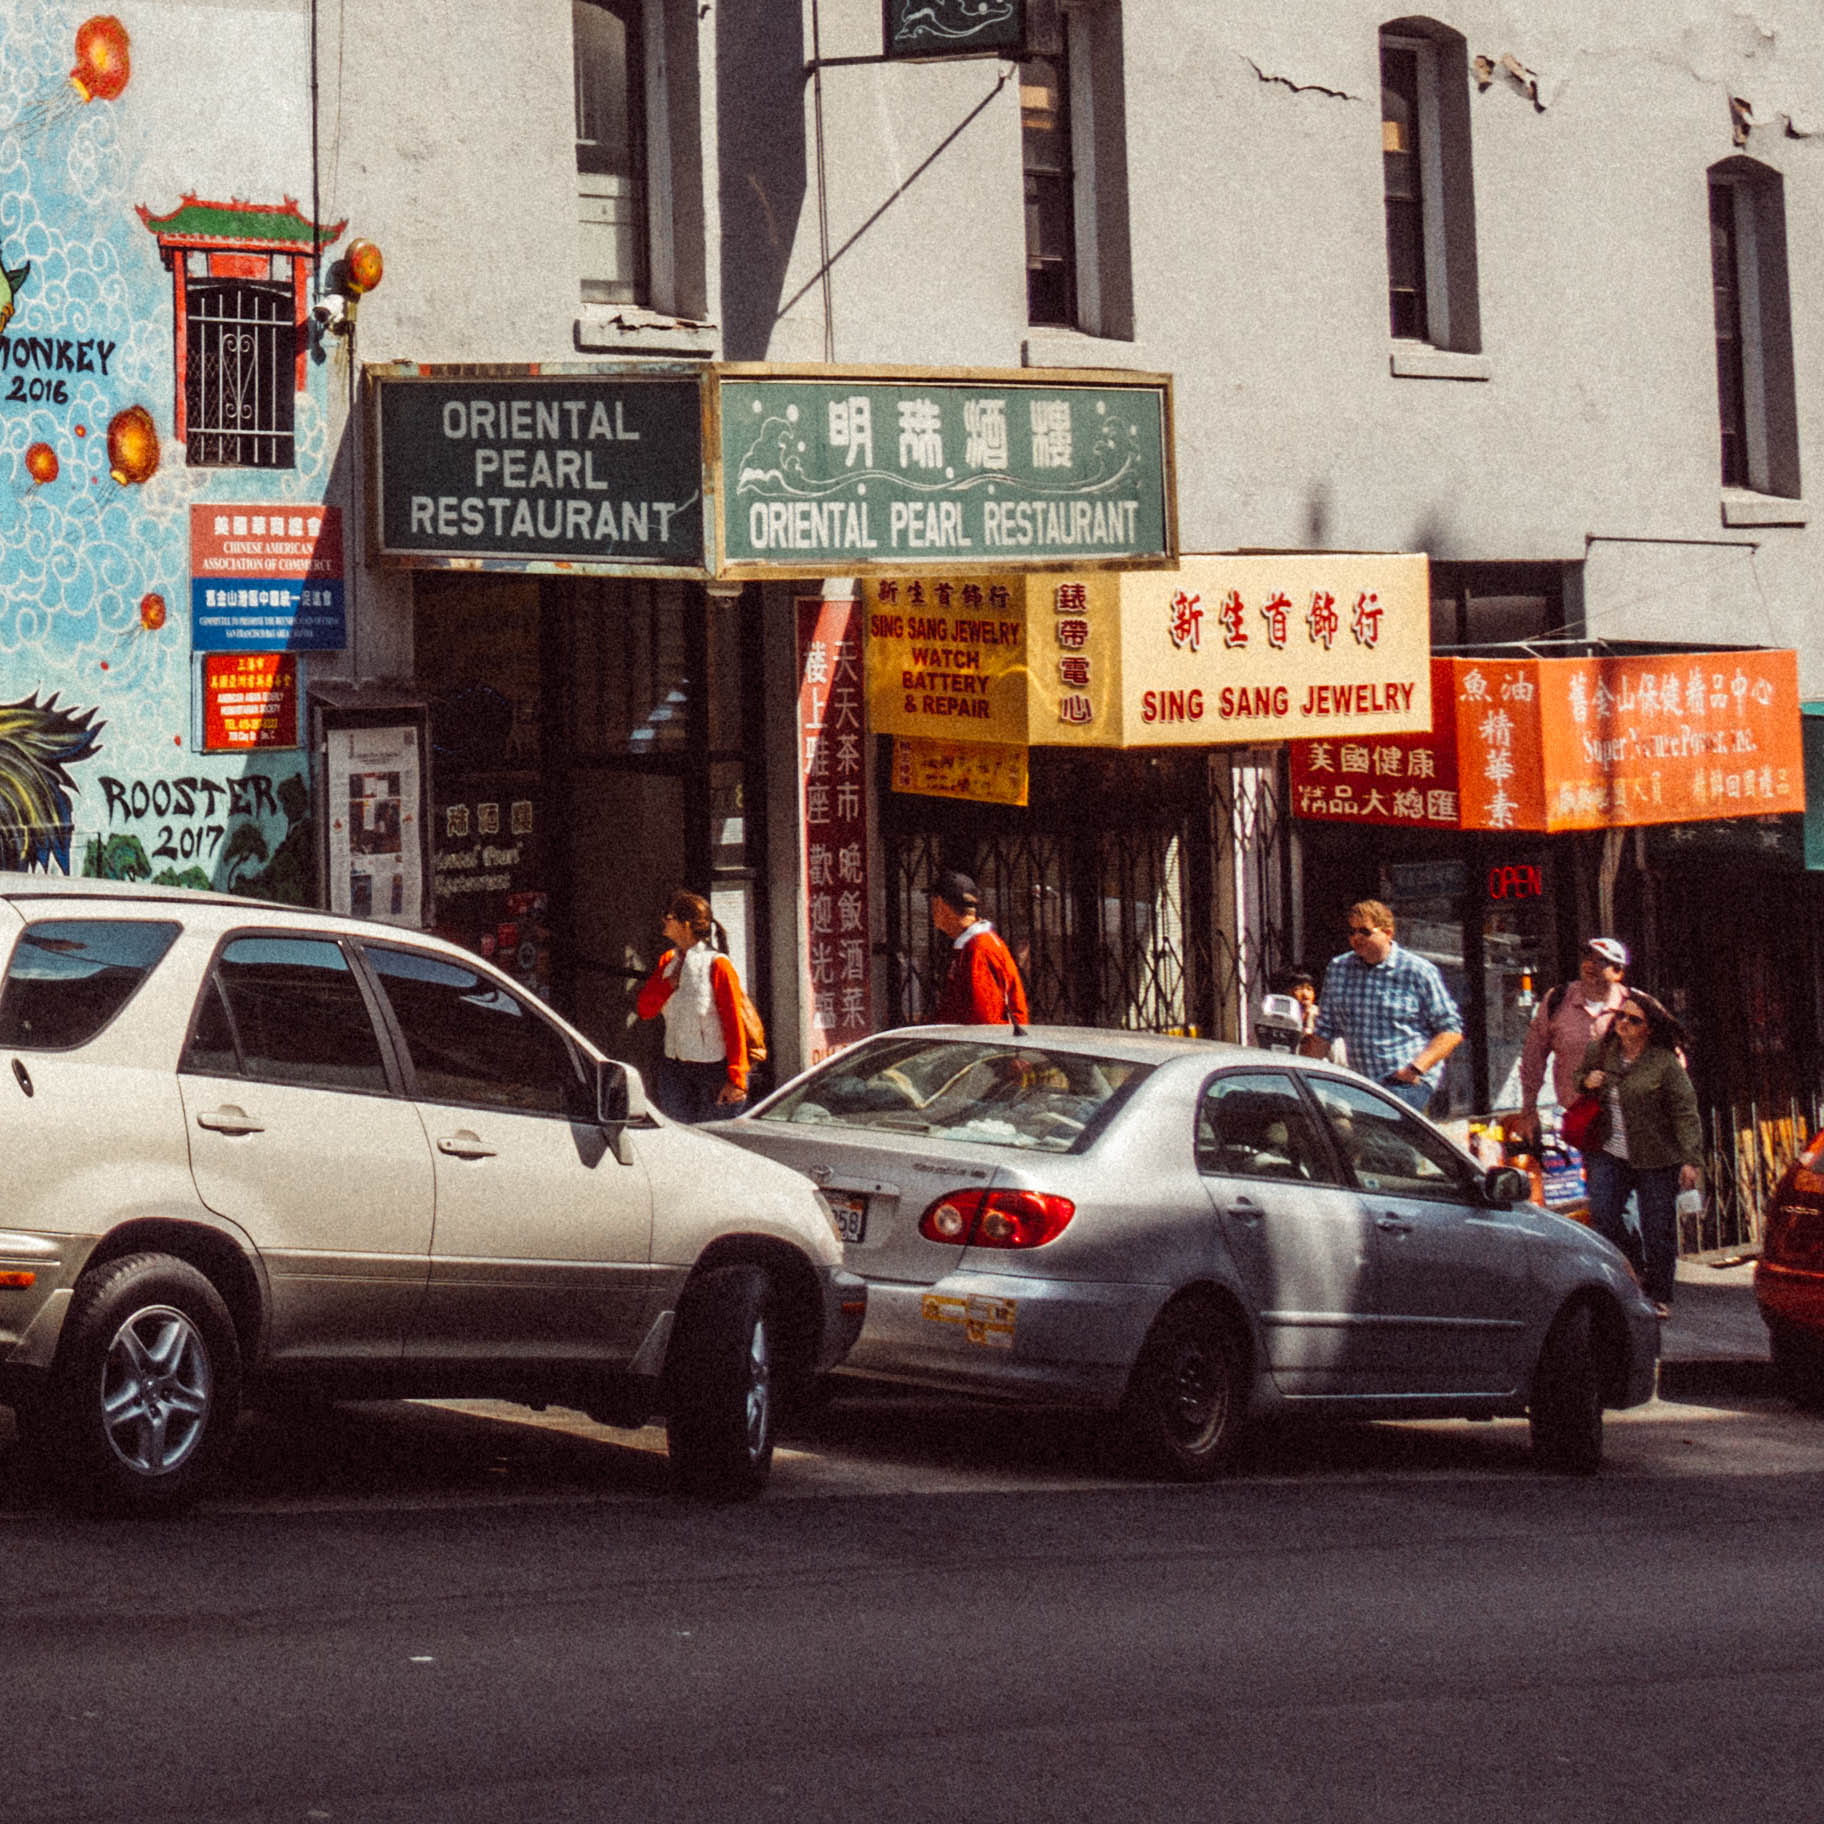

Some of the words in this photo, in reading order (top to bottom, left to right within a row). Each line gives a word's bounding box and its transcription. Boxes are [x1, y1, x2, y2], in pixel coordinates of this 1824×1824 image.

[5, 377, 69, 404] 2016
[443, 400, 640, 442] ORIENTAL
[828, 395, 1075, 470] 明珠酒樓
[474, 448, 609, 491] PEARL
[410, 496, 678, 544] RESTAURANT
[749, 499, 876, 551] ORIENTAL
[890, 500, 970, 550] PEARL
[984, 499, 1139, 549] RESTAURANT
[203, 558, 263, 571] ASSOCIATION
[264, 558, 277, 571] OF
[278, 559, 333, 572] COMMERCE
[223, 541, 264, 554] CHINESE
[265, 542, 314, 555] AMERICAN
[871, 614, 904, 638] SING
[907, 616, 947, 642] SANG
[952, 619, 1021, 645] JEWELRY
[1170, 586, 1385, 652] 新生首飾行
[911, 647, 980, 669] WATCH
[902, 671, 991, 694] BATTERY
[1459, 667, 1534, 703] 魚油
[904, 694, 917, 713] &
[923, 695, 991, 718] REPAIR
[1141, 688, 1204, 724] SING
[1219, 685, 1290, 719] SANG
[1301, 681, 1416, 717] JEWELRY
[1308, 742, 1436, 779] 美國健康
[1477, 708, 1520, 829] 精華素
[1582, 729, 1627, 771] Super
[97, 776, 277, 823] ROOSTER
[1298, 784, 1459, 822] 精品大總匯
[153, 824, 225, 861] 2017
[1489, 866, 1542, 899] OPEN
